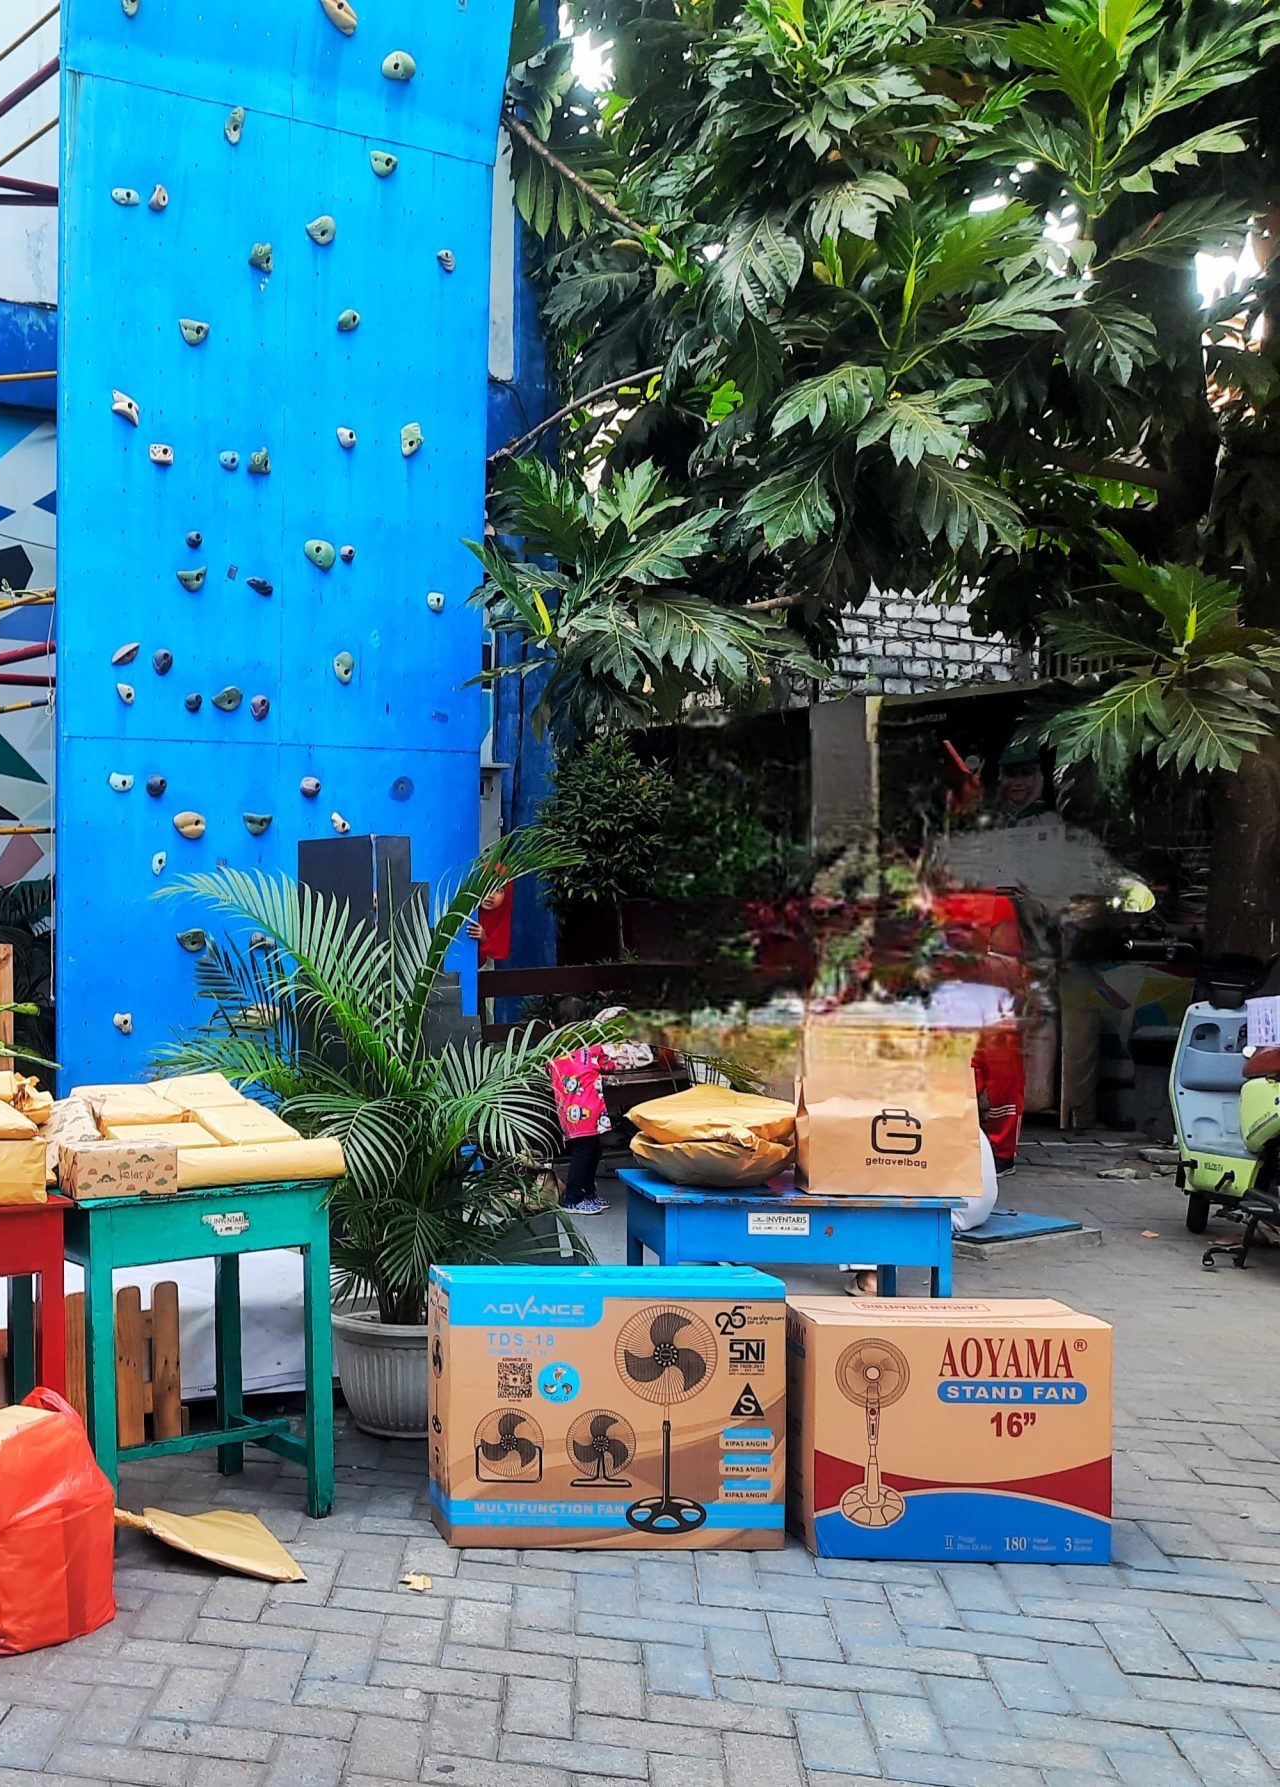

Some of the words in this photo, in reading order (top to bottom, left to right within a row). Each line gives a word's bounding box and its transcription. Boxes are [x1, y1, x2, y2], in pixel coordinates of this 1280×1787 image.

[865, 1157, 927, 1169] getravelbag
[766, 1215, 807, 1224] INVENTARIS
[483, 1295, 586, 1320] ADVANCE
[486, 1332, 555, 1346] TDS-18
[729, 1342, 765, 1360] SNI
[946, 1386, 1023, 1400] STAND
[1032, 1386, 1077, 1400] FAN
[474, 1502, 594, 1514] MULTIFUNCTION
[597, 1504, 625, 1514] FAN
[1064, 1537, 1072, 1552] 3
